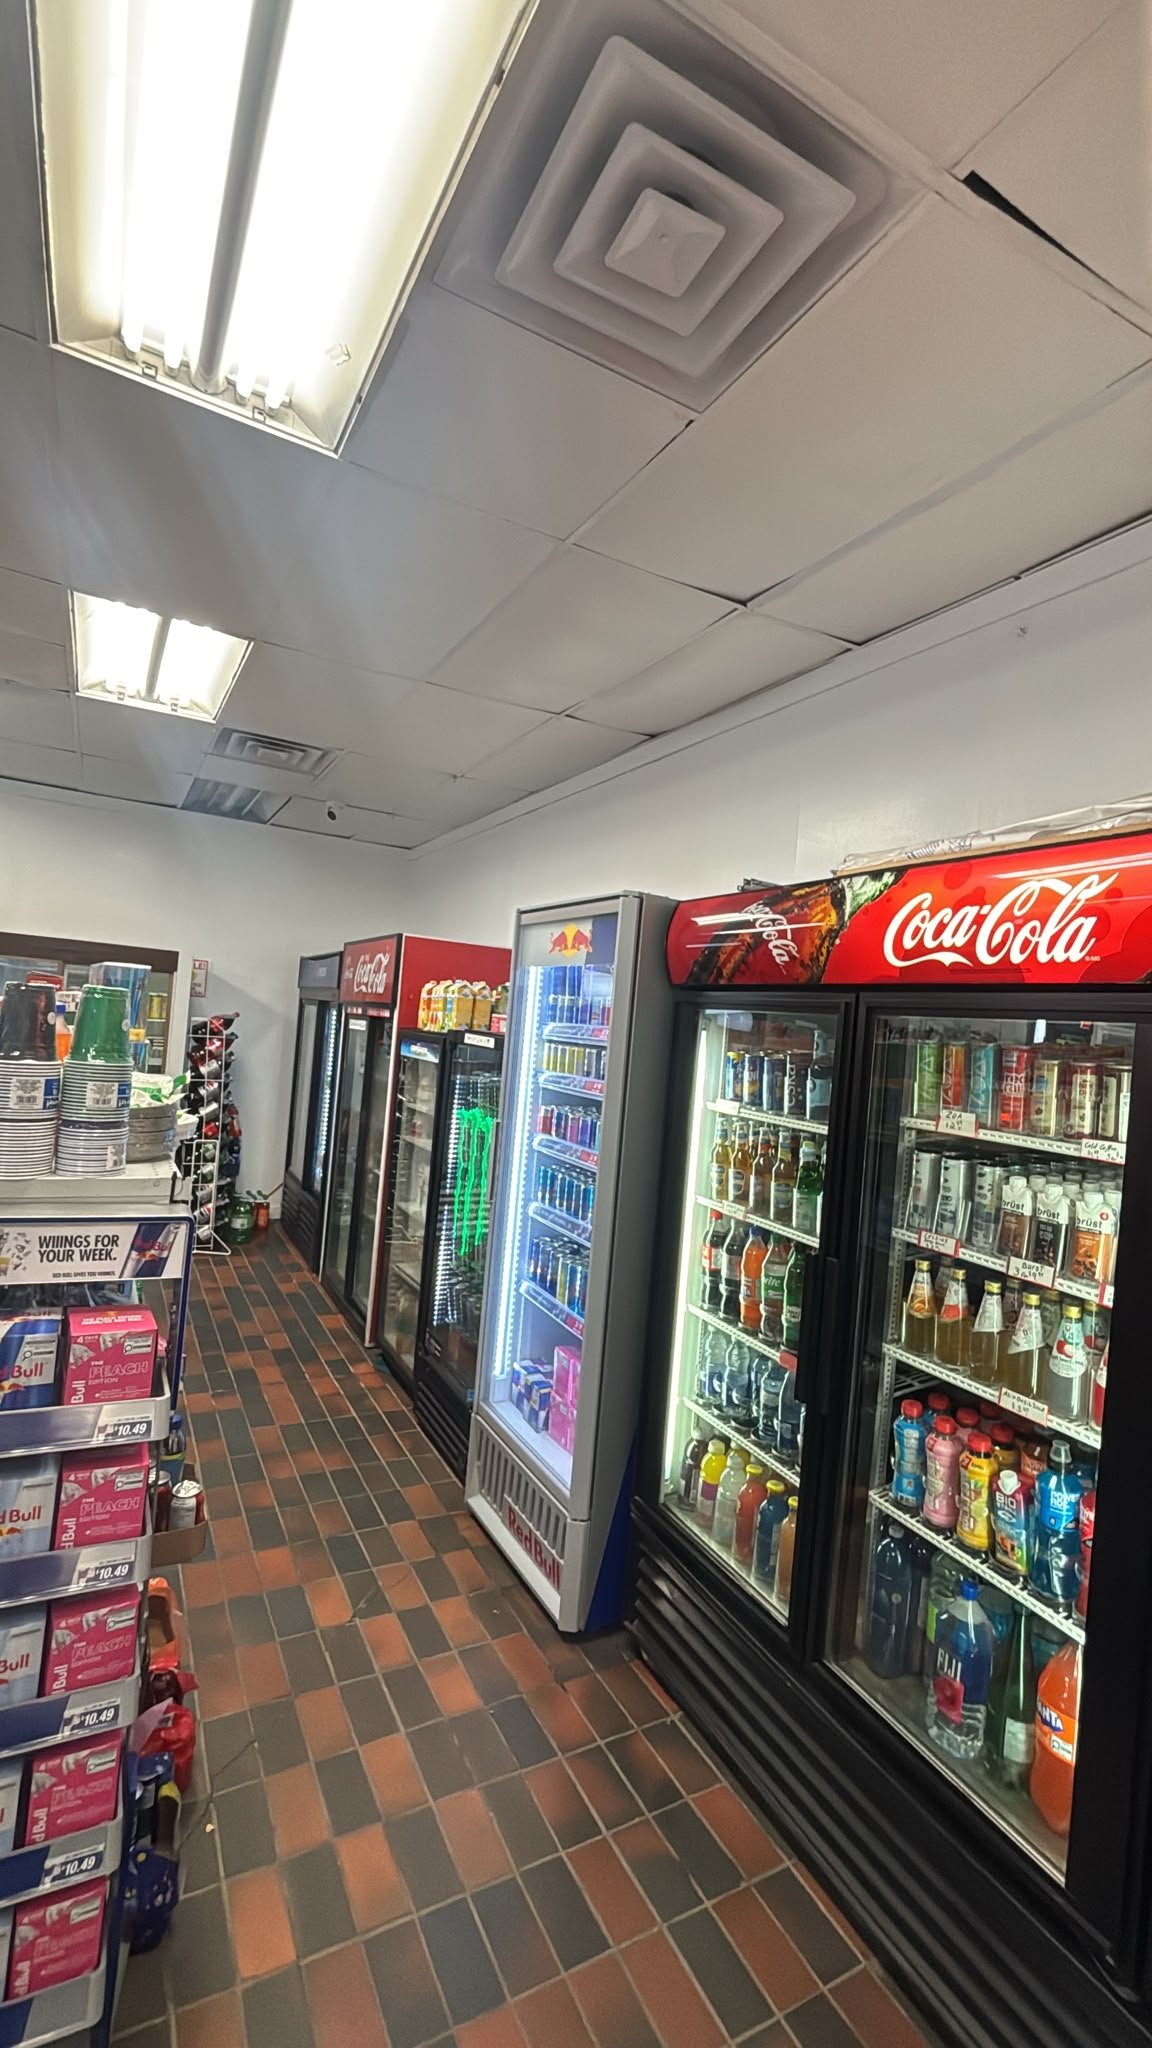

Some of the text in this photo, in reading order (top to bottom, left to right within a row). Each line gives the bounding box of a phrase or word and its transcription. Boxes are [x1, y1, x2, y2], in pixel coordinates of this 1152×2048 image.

[883, 871, 1119, 968] Coca-Cola
[1037, 1207, 1061, 1219] brüst
[38, 1234, 120, 1249] WIIINGS FOR
[38, 1248, 117, 1263] YOUR WEEK.
[77, 1336, 84, 1344] 4
[11, 1363, 44, 1379] Bull
[88, 1361, 149, 1378] PEACH
[70, 1379, 87, 1404] Bull
[9, 1505, 42, 1523] Bull
[61, 1517, 77, 1541] Bull
[508, 1503, 561, 1592] Red Bull
[0, 1653, 31, 1674] Bull
[937, 1647, 962, 1683] FIJI
[53, 1663, 69, 1688] Bull
[1037, 1697, 1063, 1730] ANTA
